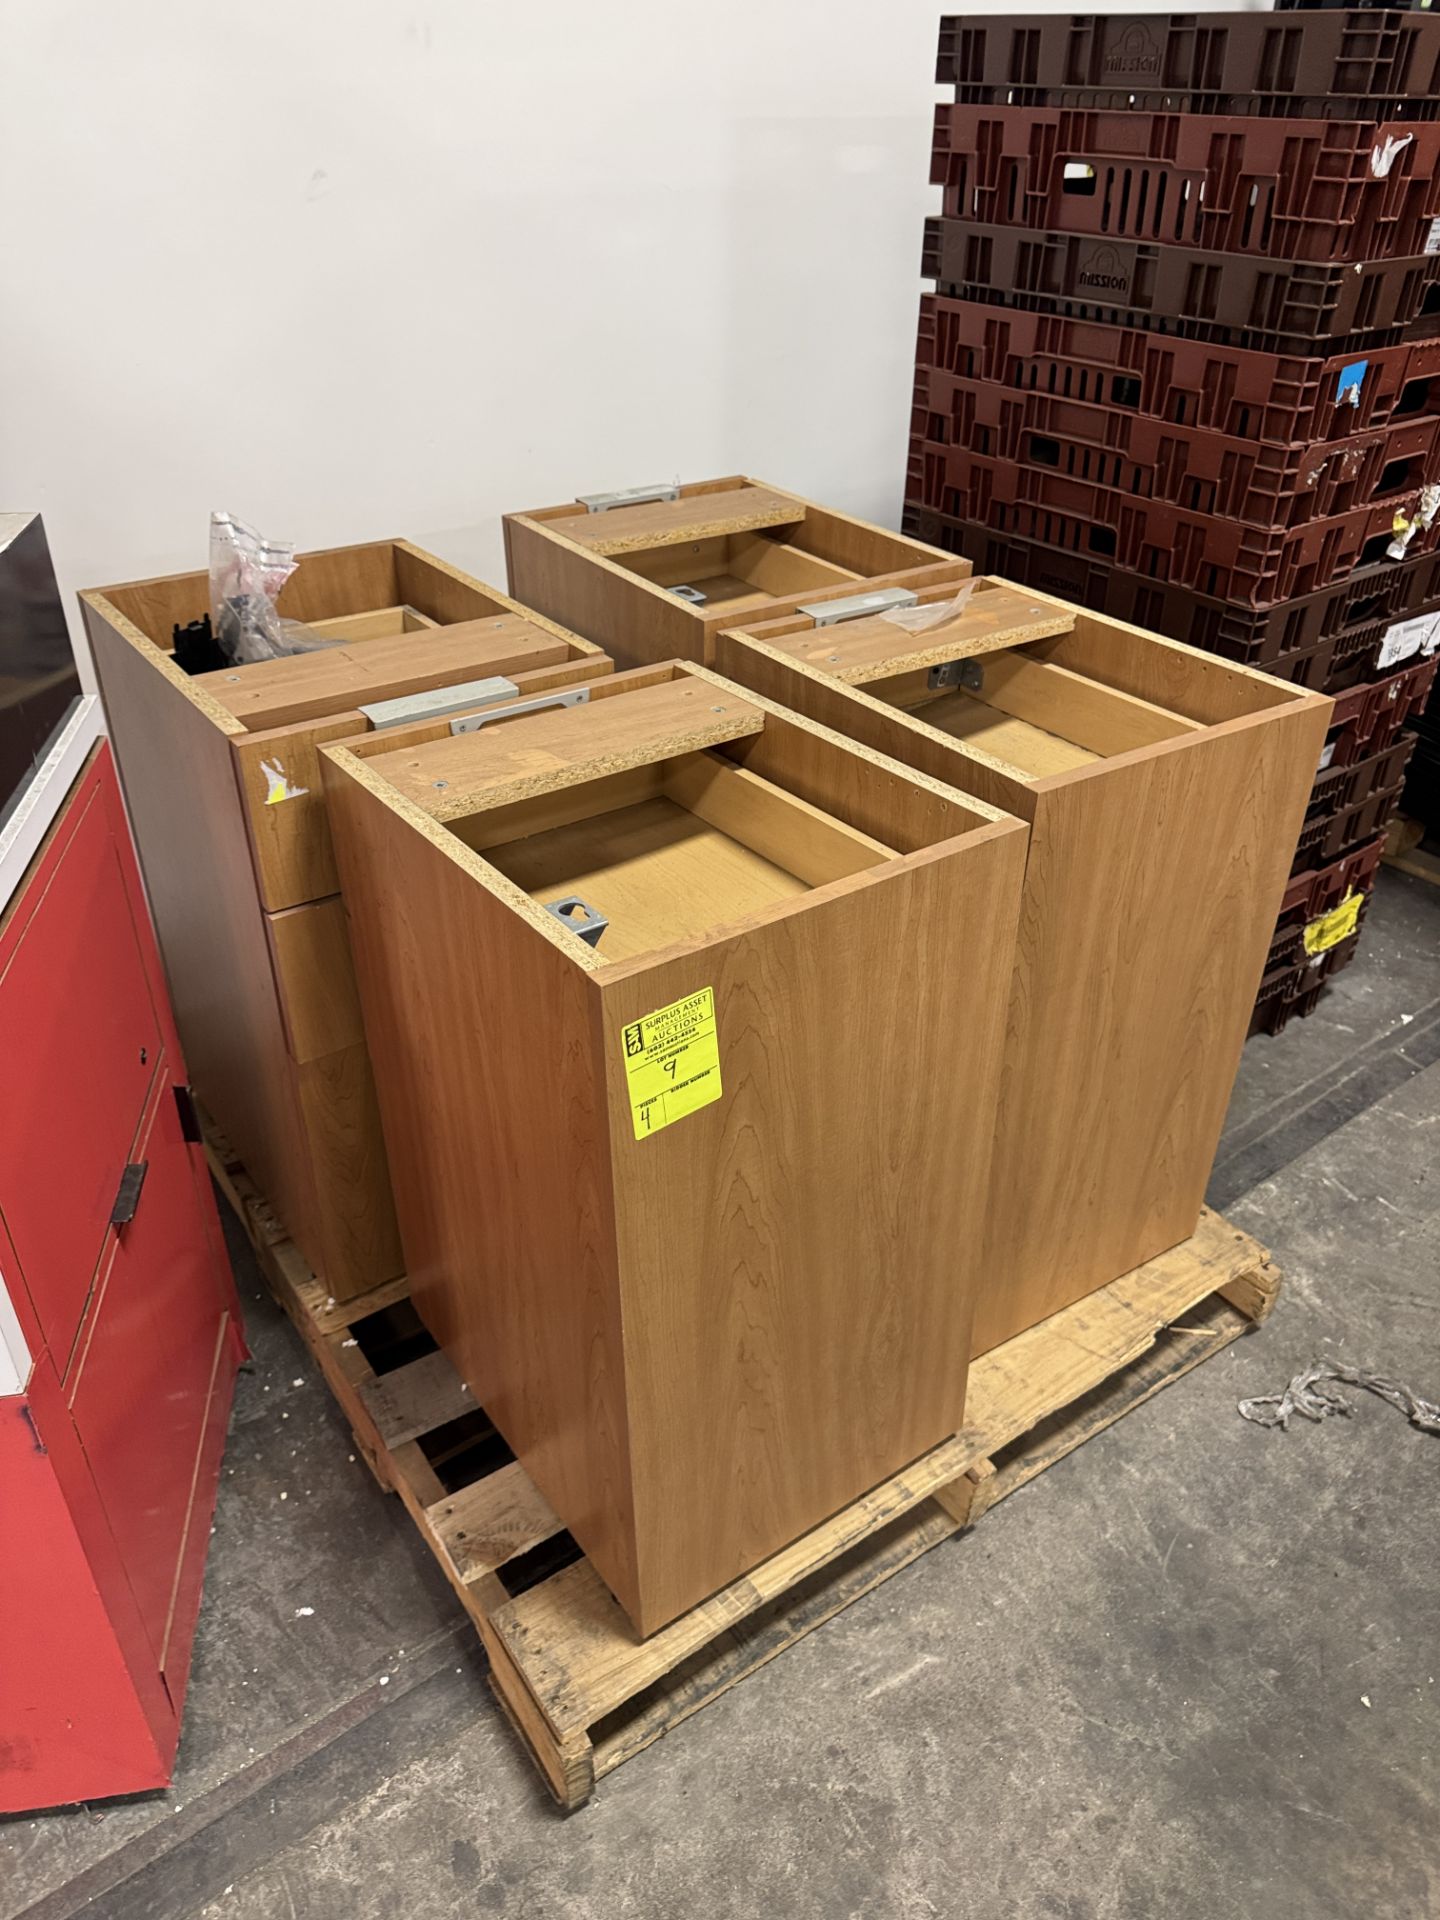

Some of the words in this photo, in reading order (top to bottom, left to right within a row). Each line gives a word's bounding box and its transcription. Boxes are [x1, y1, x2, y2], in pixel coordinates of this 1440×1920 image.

[645, 1008, 681, 1030] SURPLUS
[683, 994, 708, 1012] ASSET
[654, 1007, 700, 1031] MANAGEMENT
[651, 1012, 704, 1043] AUCTIONS
[656, 1054, 667, 1064] LOT
[663, 1058, 677, 1079] 9
[641, 1107, 651, 1130] 4
